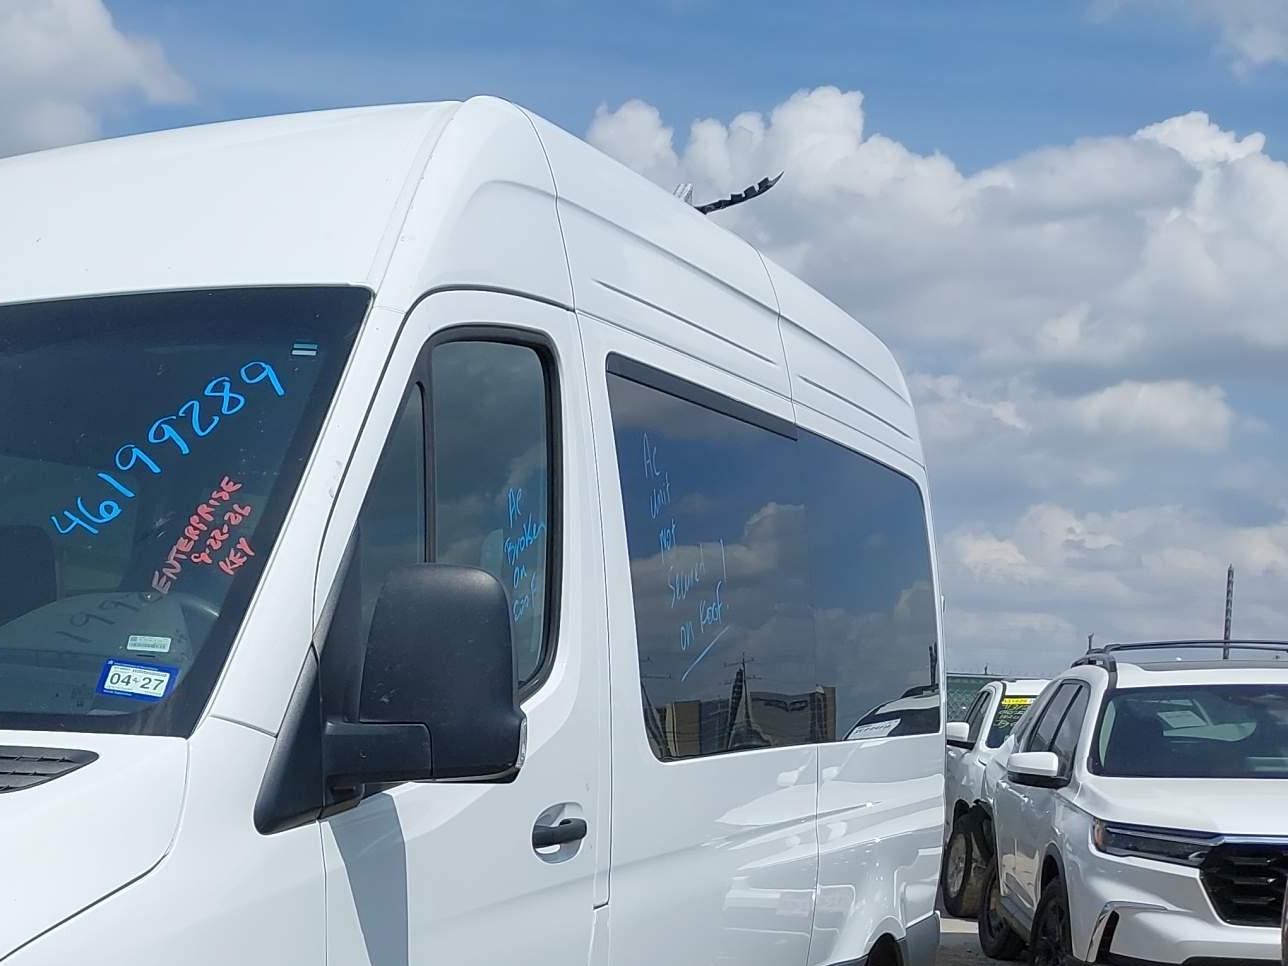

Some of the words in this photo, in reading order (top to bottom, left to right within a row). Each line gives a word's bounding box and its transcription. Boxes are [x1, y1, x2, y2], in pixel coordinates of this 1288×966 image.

[51, 361, 285, 534] 46199289
[152, 476, 242, 594] ENTERPRISE
[219, 537, 255, 575] KEY
